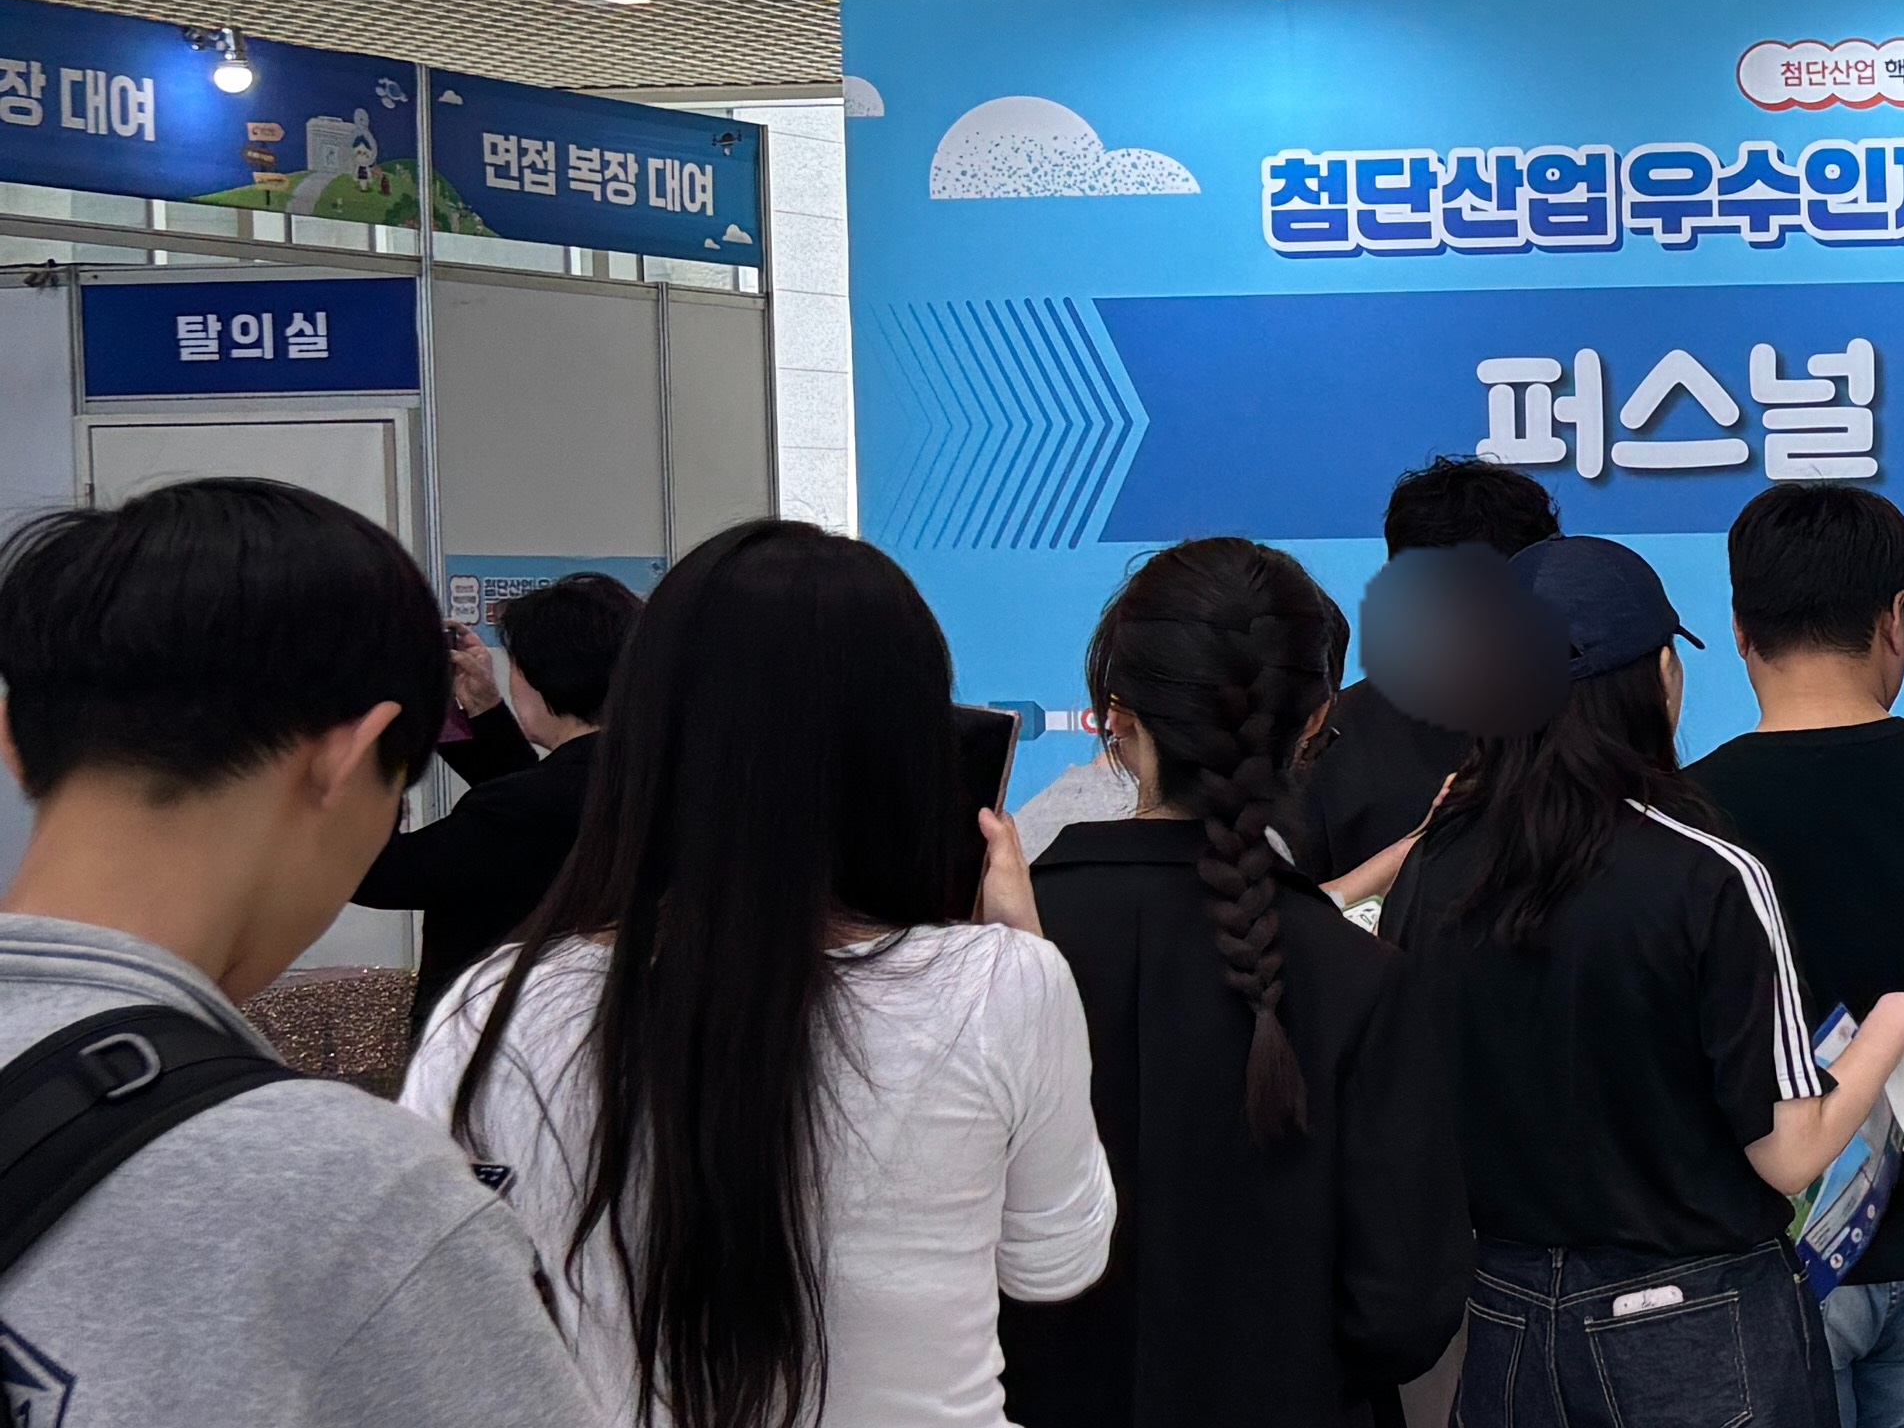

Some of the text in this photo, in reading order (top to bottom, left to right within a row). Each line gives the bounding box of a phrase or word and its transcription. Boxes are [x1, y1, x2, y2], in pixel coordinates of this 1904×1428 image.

[60, 67, 156, 142] 대여
[1780, 59, 1877, 88] 첨단산업
[482, 132, 714, 217] 면접 복장 대여
[176, 311, 330, 362] 탈의실
[1475, 337, 1879, 481] 퍼스널
